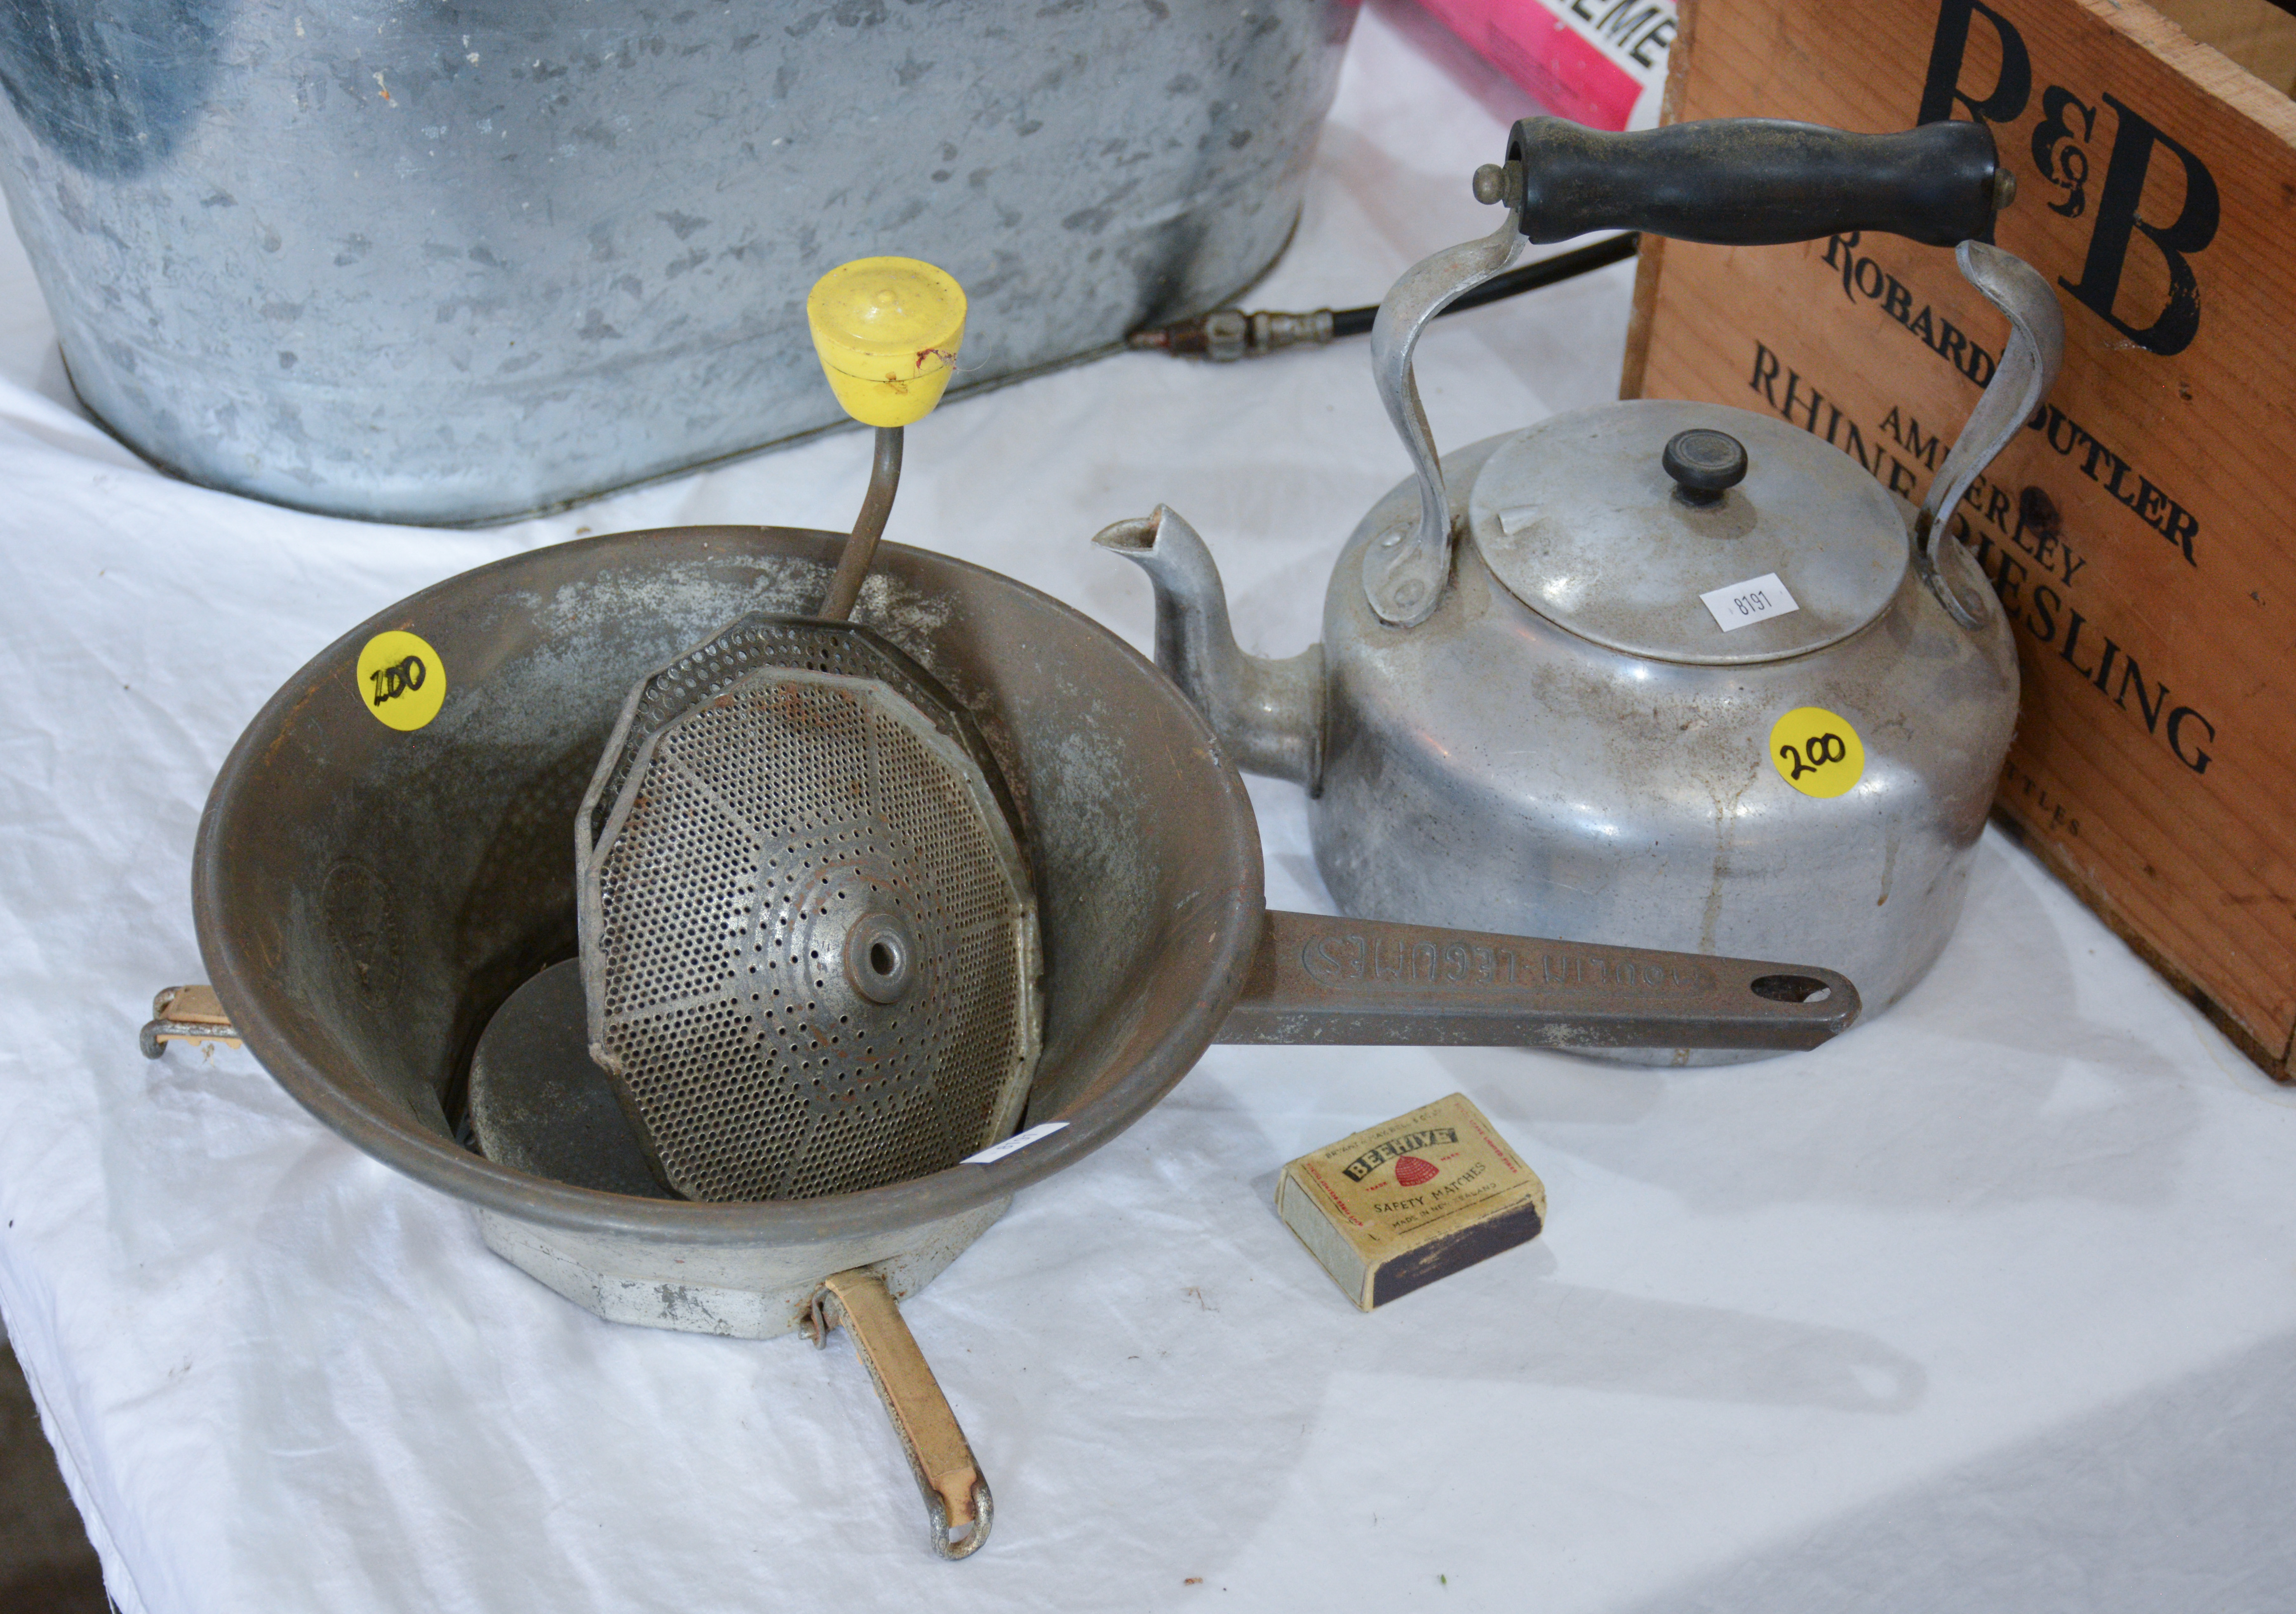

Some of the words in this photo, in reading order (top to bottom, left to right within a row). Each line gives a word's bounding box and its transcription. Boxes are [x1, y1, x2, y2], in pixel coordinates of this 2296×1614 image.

[1821, 231, 1995, 389] ROBARD
[1879, 406, 2086, 587] AMERLEY
[1749, 340, 1916, 499] RHINE
[1956, 513, 2216, 774] IESLING
[1734, 591, 1772, 615] 8191
[370, 656, 426, 707] 200
[1780, 733, 1845, 780] 200
[1347, 1129, 1451, 1178] BEEHIVE
[1374, 1196, 1424, 1213] SAFETY
[1431, 1162, 1486, 1201] MATCHES
[1392, 1216, 1418, 1228] MADE
